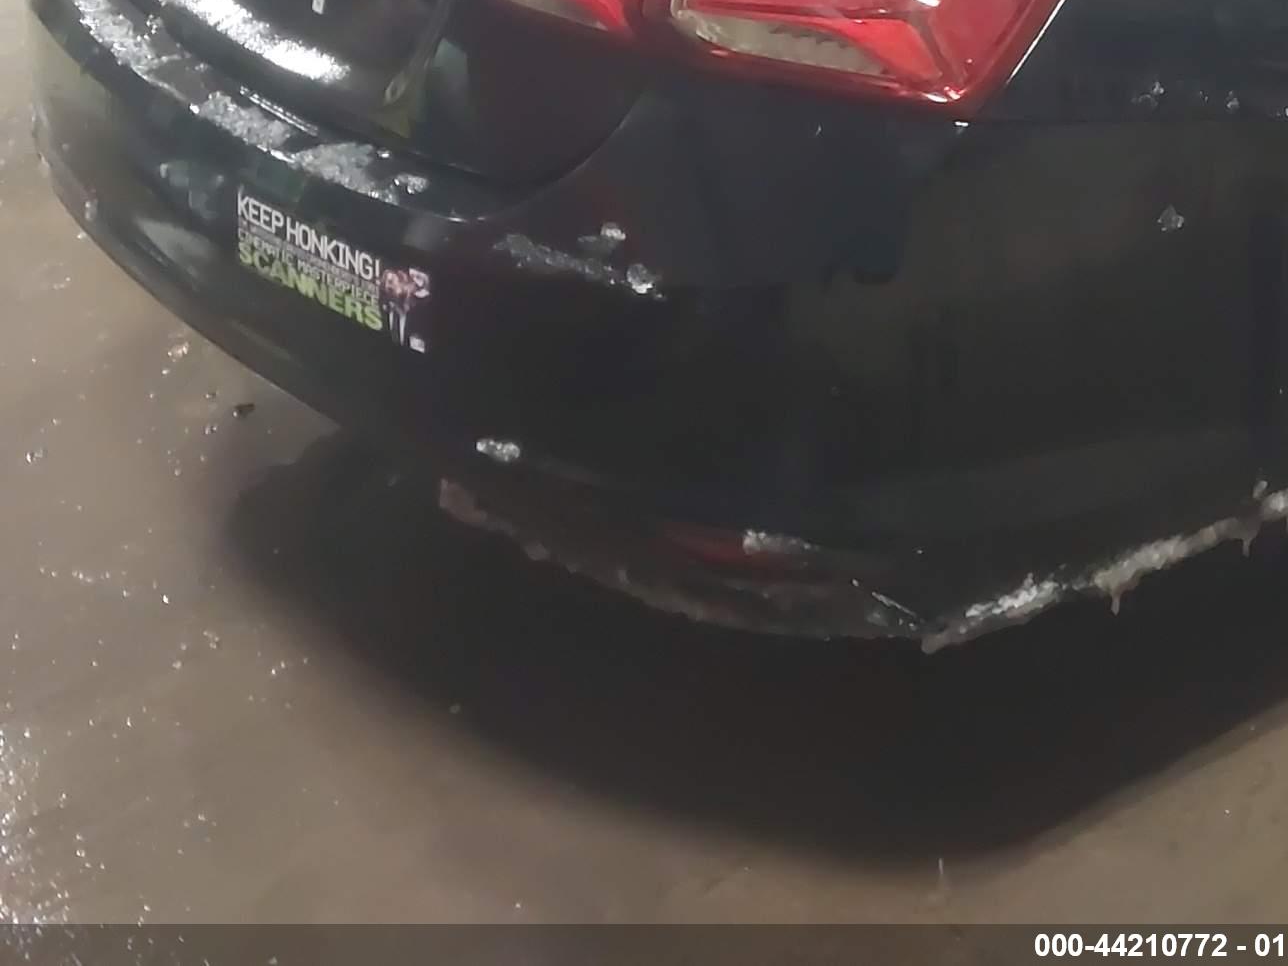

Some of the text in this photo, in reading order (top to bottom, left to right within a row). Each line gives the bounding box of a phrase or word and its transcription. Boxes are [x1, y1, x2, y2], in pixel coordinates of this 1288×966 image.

[238, 197, 284, 232] KEEP
[287, 217, 381, 286] HONKING!
[239, 242, 382, 330] SCANNERS
